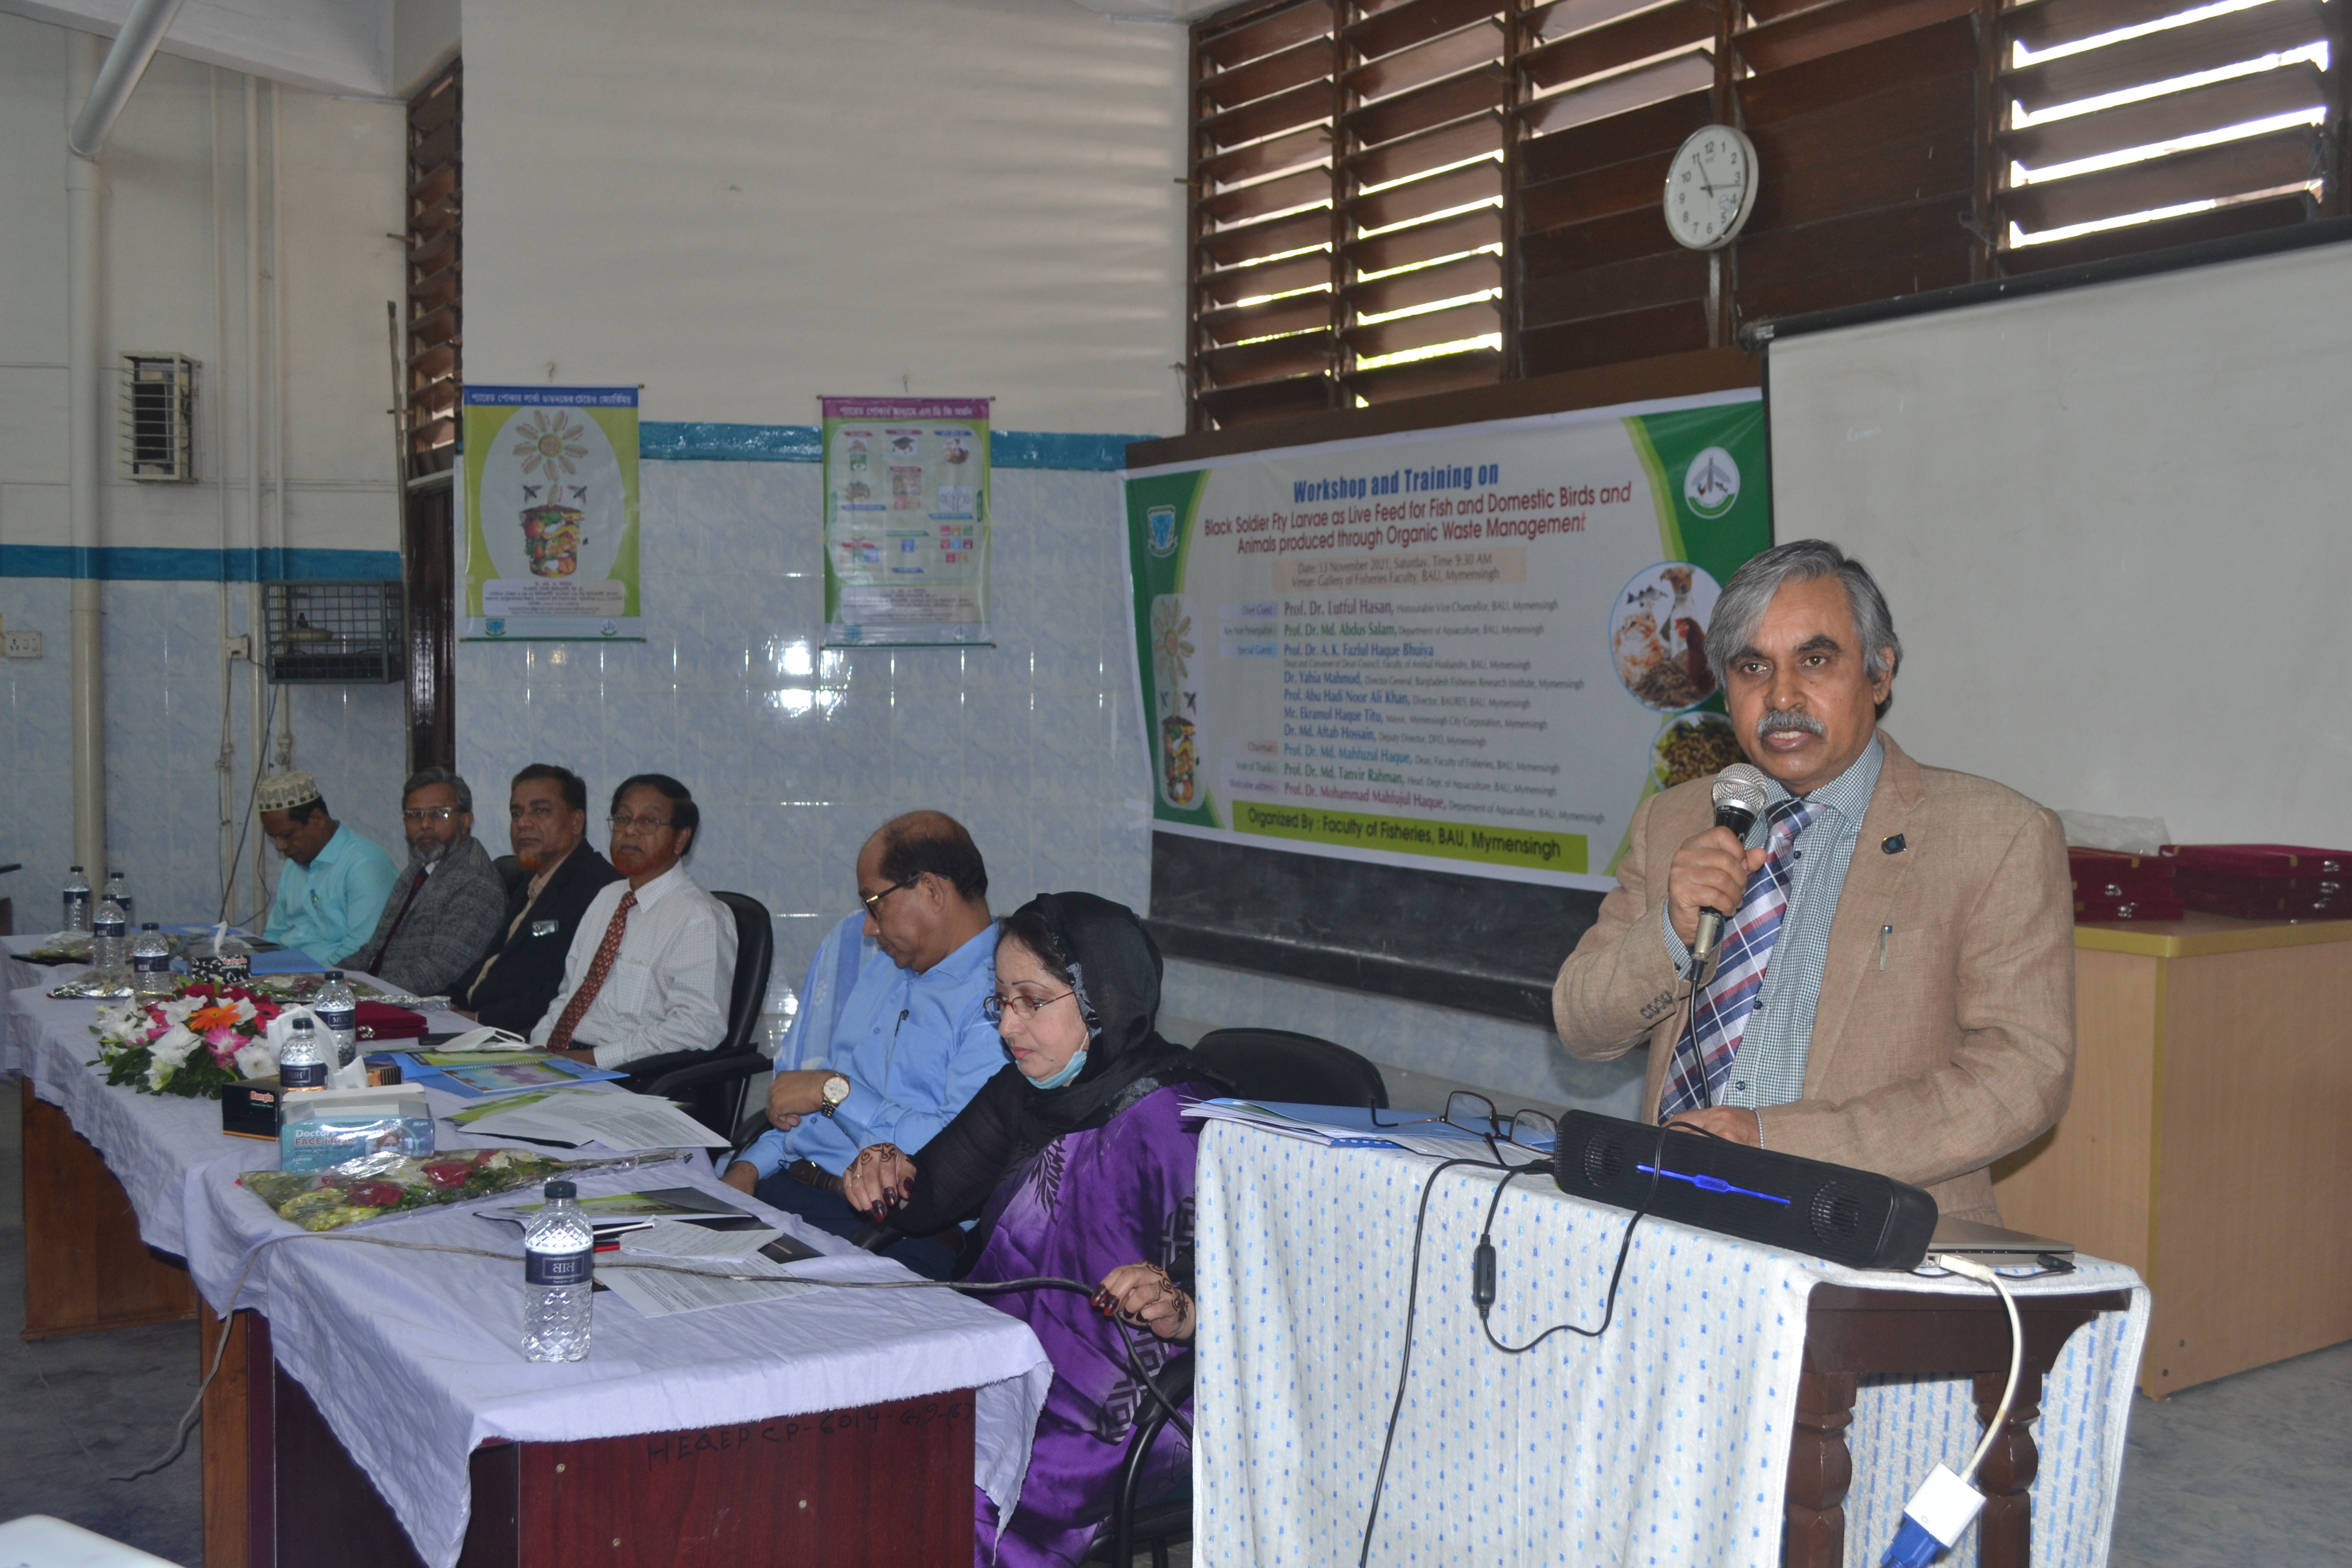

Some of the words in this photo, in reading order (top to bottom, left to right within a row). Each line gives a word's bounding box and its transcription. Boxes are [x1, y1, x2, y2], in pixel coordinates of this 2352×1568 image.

[1705, 141, 1714, 154] 12
[1721, 142, 1725, 152] 1
[1731, 152, 1736, 164] 2
[1681, 171, 1691, 183] 10
[1735, 172, 1741, 183] 3
[1679, 193, 1685, 204] 9
[1683, 211, 1688, 223] 8
[1721, 212, 1726, 224] 5
[1693, 222, 1699, 233] 7
[1707, 223, 1712, 234] 6
[1294, 476, 1366, 503] Workshop
[1371, 471, 1399, 496] and
[1404, 464, 1473, 492] Training
[1478, 463, 1499, 485] on
[1205, 518, 1232, 535] Black
[1236, 516, 1269, 533] Soldier
[1291, 511, 1327, 529] Larvae
[1332, 510, 1344, 525] as
[1348, 506, 1371, 524] Live
[1376, 502, 1405, 522] Feed
[1409, 501, 1426, 519] for
[1430, 497, 1453, 517] Fish
[1457, 495, 1484, 516] and
[1488, 488, 1554, 513] Domestic
[1560, 485, 1595, 506] Birds
[1600, 481, 1632, 504] and
[1237, 536, 1276, 554] Animals
[1280, 530, 1334, 554] produced
[1338, 528, 1382, 550] through
[1387, 523, 1438, 548] Organic
[1442, 520, 1482, 541] Waste
[1487, 513, 1586, 540] Management
[1331, 560, 1368, 571] November
[1477, 553, 1491, 564] AM
[1345, 573, 1353, 584] of
[1355, 572, 1387, 584] Fisheries
[1446, 567, 1500, 583] Mymensingh
[1285, 600, 1306, 616] Prof.
[1310, 600, 1324, 615] Dr.
[1328, 599, 1356, 615] Lutful
[1360, 598, 1394, 616] Hasan,
[1285, 623, 1302, 636] Prof.
[1305, 623, 1318, 636] Dr.
[1321, 622, 1336, 635] Md.
[1340, 622, 1365, 635] Abdus
[1368, 621, 1396, 637] Salam,
[1284, 643, 1302, 655] Prof.
[1305, 643, 1318, 656] Dr.
[1321, 644, 1330, 655] A.
[1332, 643, 1340, 655] K.
[1343, 642, 1368, 656] Fazlul
[1371, 643, 1400, 659] Haque
[1285, 671, 1297, 683] Dr.
[1300, 670, 1320, 683] Yahia
[1324, 670, 1362, 686] Mahmud,
[1285, 688, 1303, 701] Prof.
[1306, 688, 1321, 701] Abu
[1324, 688, 1343, 701] Hadi
[1345, 689, 1367, 702] Noor
[1371, 689, 1383, 703] Ali
[1385, 690, 1410, 706] Khan,
[1284, 706, 1297, 718] Mr.
[1300, 706, 1332, 719] Ekramul
[1335, 707, 1361, 724] Haque
[1364, 708, 1384, 723] Titu,
[1284, 723, 1297, 736] Dr.
[1300, 724, 1314, 737] Md.
[1317, 724, 1338, 738] Aftab
[1341, 726, 1377, 741] Hossain,
[1285, 743, 1302, 756] Prof.
[1305, 744, 1317, 757] Dr.
[1321, 745, 1336, 758] Md.
[1339, 746, 1378, 761] Mahfuzul
[1381, 749, 1412, 766] Haque,
[1285, 763, 1302, 776] Prof.
[1305, 764, 1318, 777] Dr.
[1320, 765, 1336, 778] Md.
[1338, 766, 1365, 780] Tanvir
[1367, 768, 1405, 786] Rahman,
[1284, 782, 1303, 796] Prof.
[1305, 783, 1317, 796] Dr.
[1320, 785, 1369, 801] Mohammad
[1413, 793, 1447, 811] Haque,
[1248, 807, 1299, 828] Organized
[1301, 814, 1314, 832] By
[1322, 815, 1363, 839] Faculty
[1366, 821, 1378, 836] of
[1381, 821, 1435, 846] Fisheries,
[1438, 827, 1468, 850] BAU,
[1471, 830, 1561, 861] Mymensingh
[251, 1091, 274, 1102] Bangla
[295, 1137, 322, 1145] FACE
[325, 1136, 355, 1145] MASK
[553, 1262, 575, 1273] মাম
